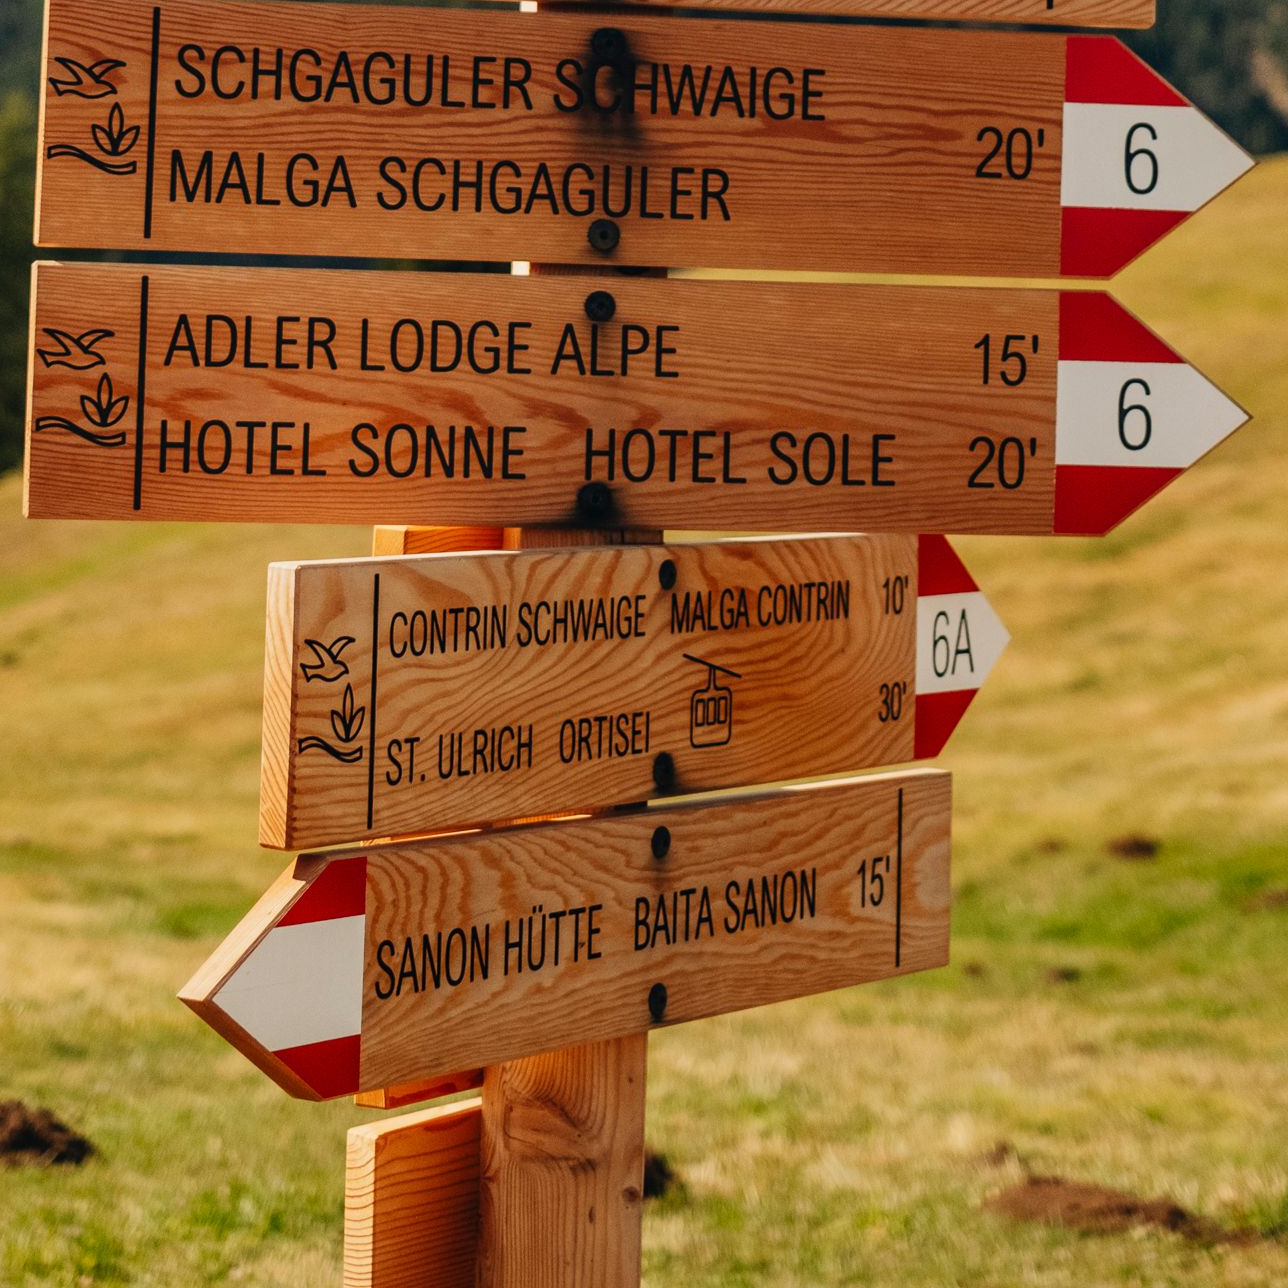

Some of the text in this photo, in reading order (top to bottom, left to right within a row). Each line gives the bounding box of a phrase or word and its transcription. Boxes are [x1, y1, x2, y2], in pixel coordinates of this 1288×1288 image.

[175, 44, 825, 121] SCHGAGULER SCHWAIGE
[169, 150, 731, 221] MALGA SCHGAGULER
[975, 127, 1044, 180] 20'
[1124, 122, 1158, 194] 6
[164, 314, 1039, 386] ADLER LODGE ALPE 15'
[1118, 378, 1152, 451] 6
[159, 419, 1036, 489] HOTEL SONNE HOTEL SOLE 20'
[389, 576, 908, 658] CONTRIN SCHWAIGE MALGA CONTRIN 10'
[932, 609, 974, 677] 6A
[386, 681, 906, 786] ST. ULRICH ORTISEI 30'
[375, 856, 890, 1000] SANON HÜTTE BAITA SANON 15'
